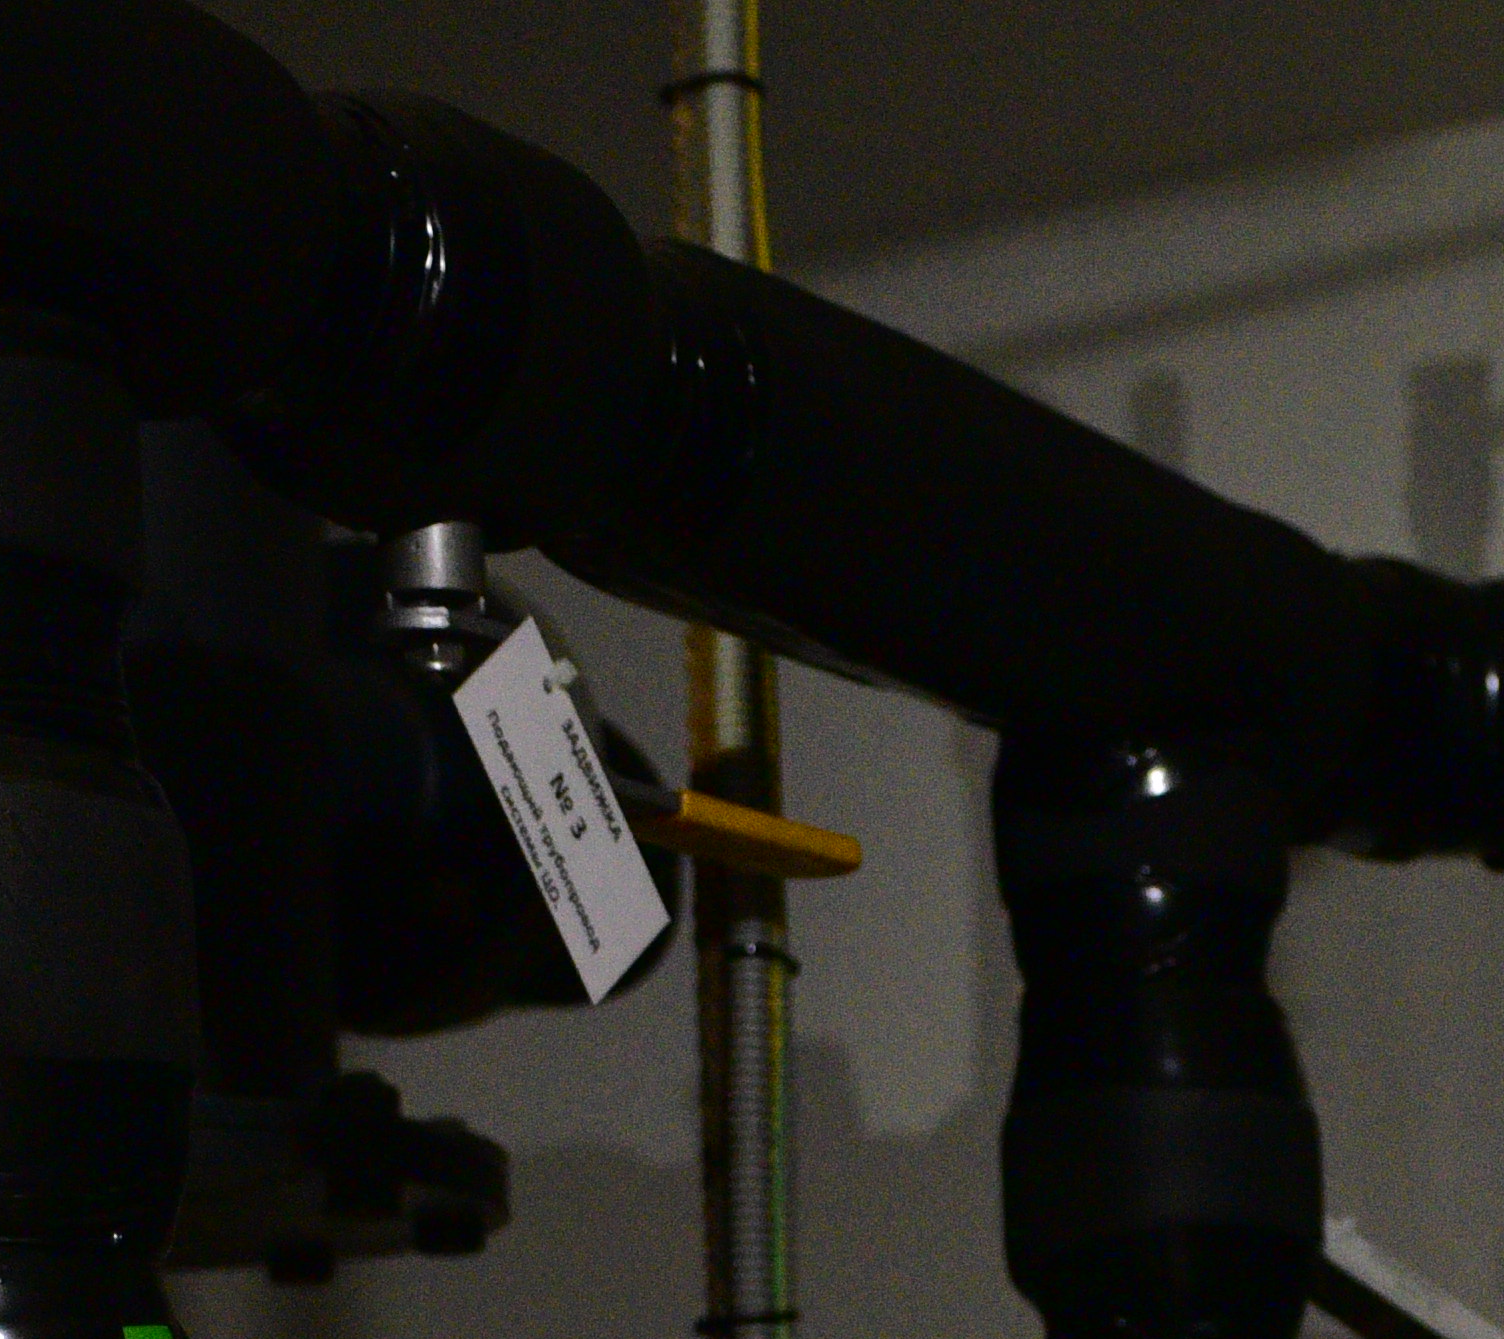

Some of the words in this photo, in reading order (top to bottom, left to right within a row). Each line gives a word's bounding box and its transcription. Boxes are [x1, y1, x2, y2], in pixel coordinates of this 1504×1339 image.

[488, 709, 542, 820] Подающий
[539, 824, 600, 954] трубопровод
[501, 784, 542, 870] системы
[548, 772, 573, 814] №
[571, 820, 587, 840] 3
[561, 719, 621, 843] ЗАДВИЖКА
